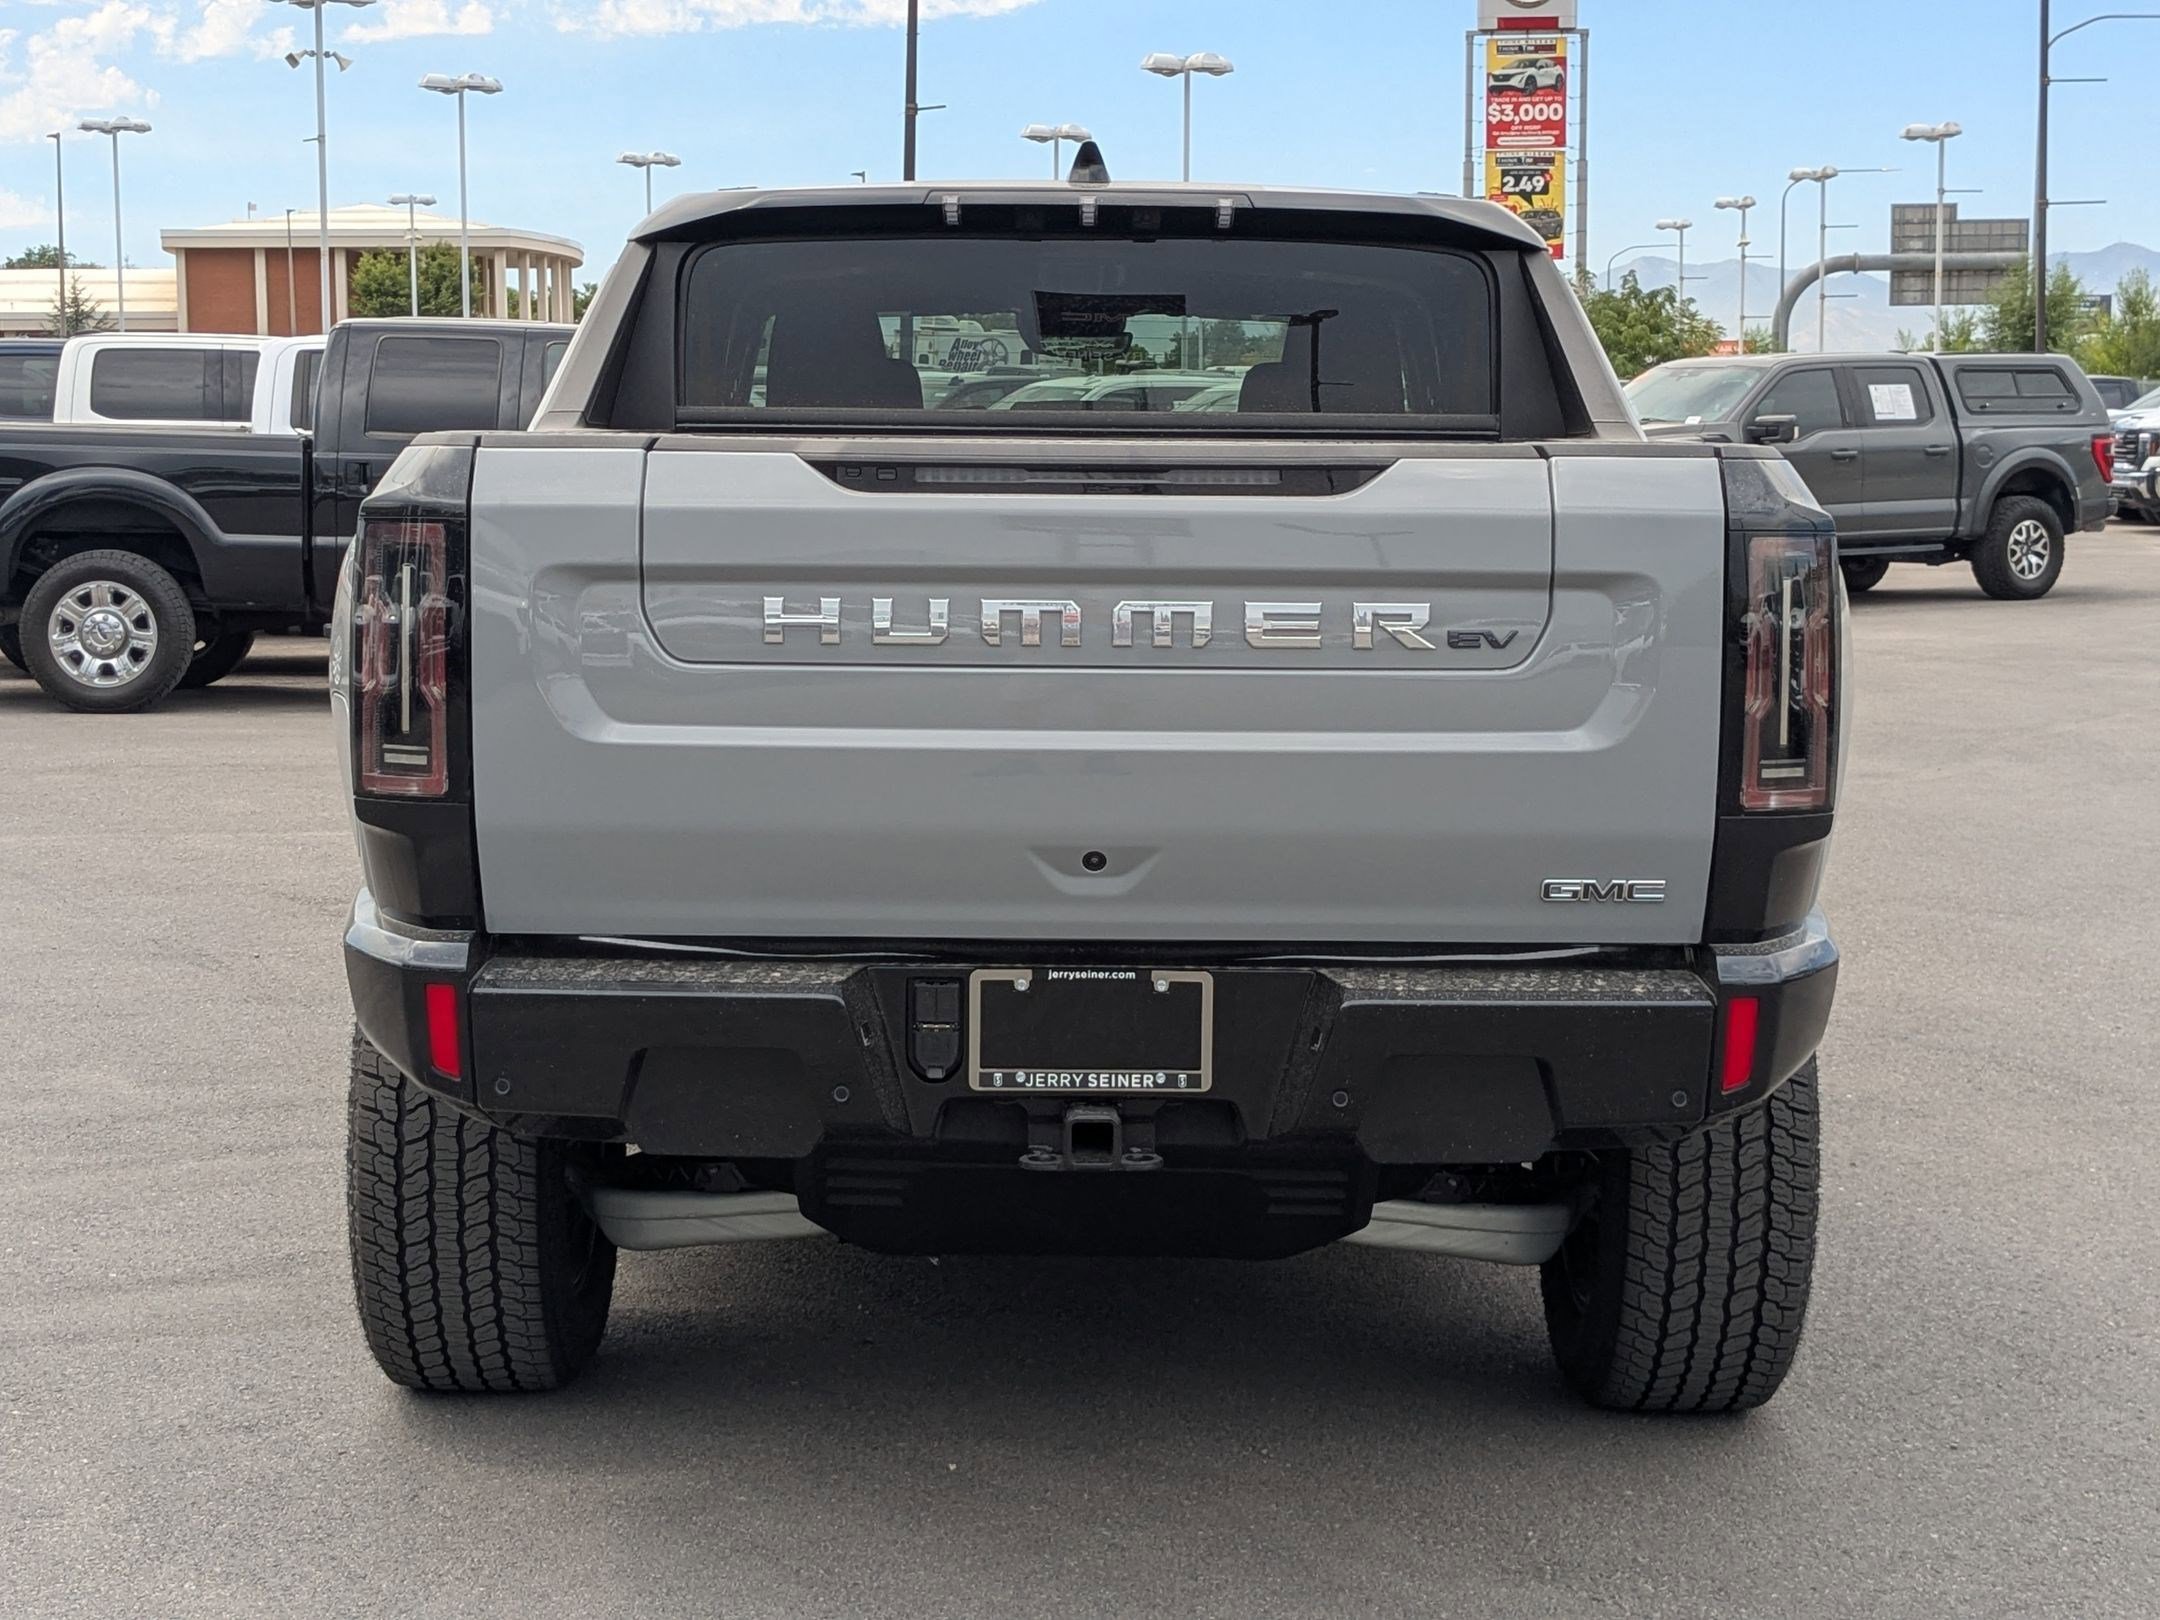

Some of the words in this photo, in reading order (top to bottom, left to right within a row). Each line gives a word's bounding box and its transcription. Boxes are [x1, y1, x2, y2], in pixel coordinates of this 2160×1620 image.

[1488, 102, 1563, 124] $3,000
[951, 338, 980, 350] Alloy
[763, 596, 1436, 650] HUMMER
[1446, 629, 1519, 649] EV
[1540, 878, 1666, 902] GMC
[1047, 969, 1137, 980] jerryseiner.com
[1025, 1073, 1084, 1087] JERRY
[1087, 1074, 1154, 1088] SEINER
